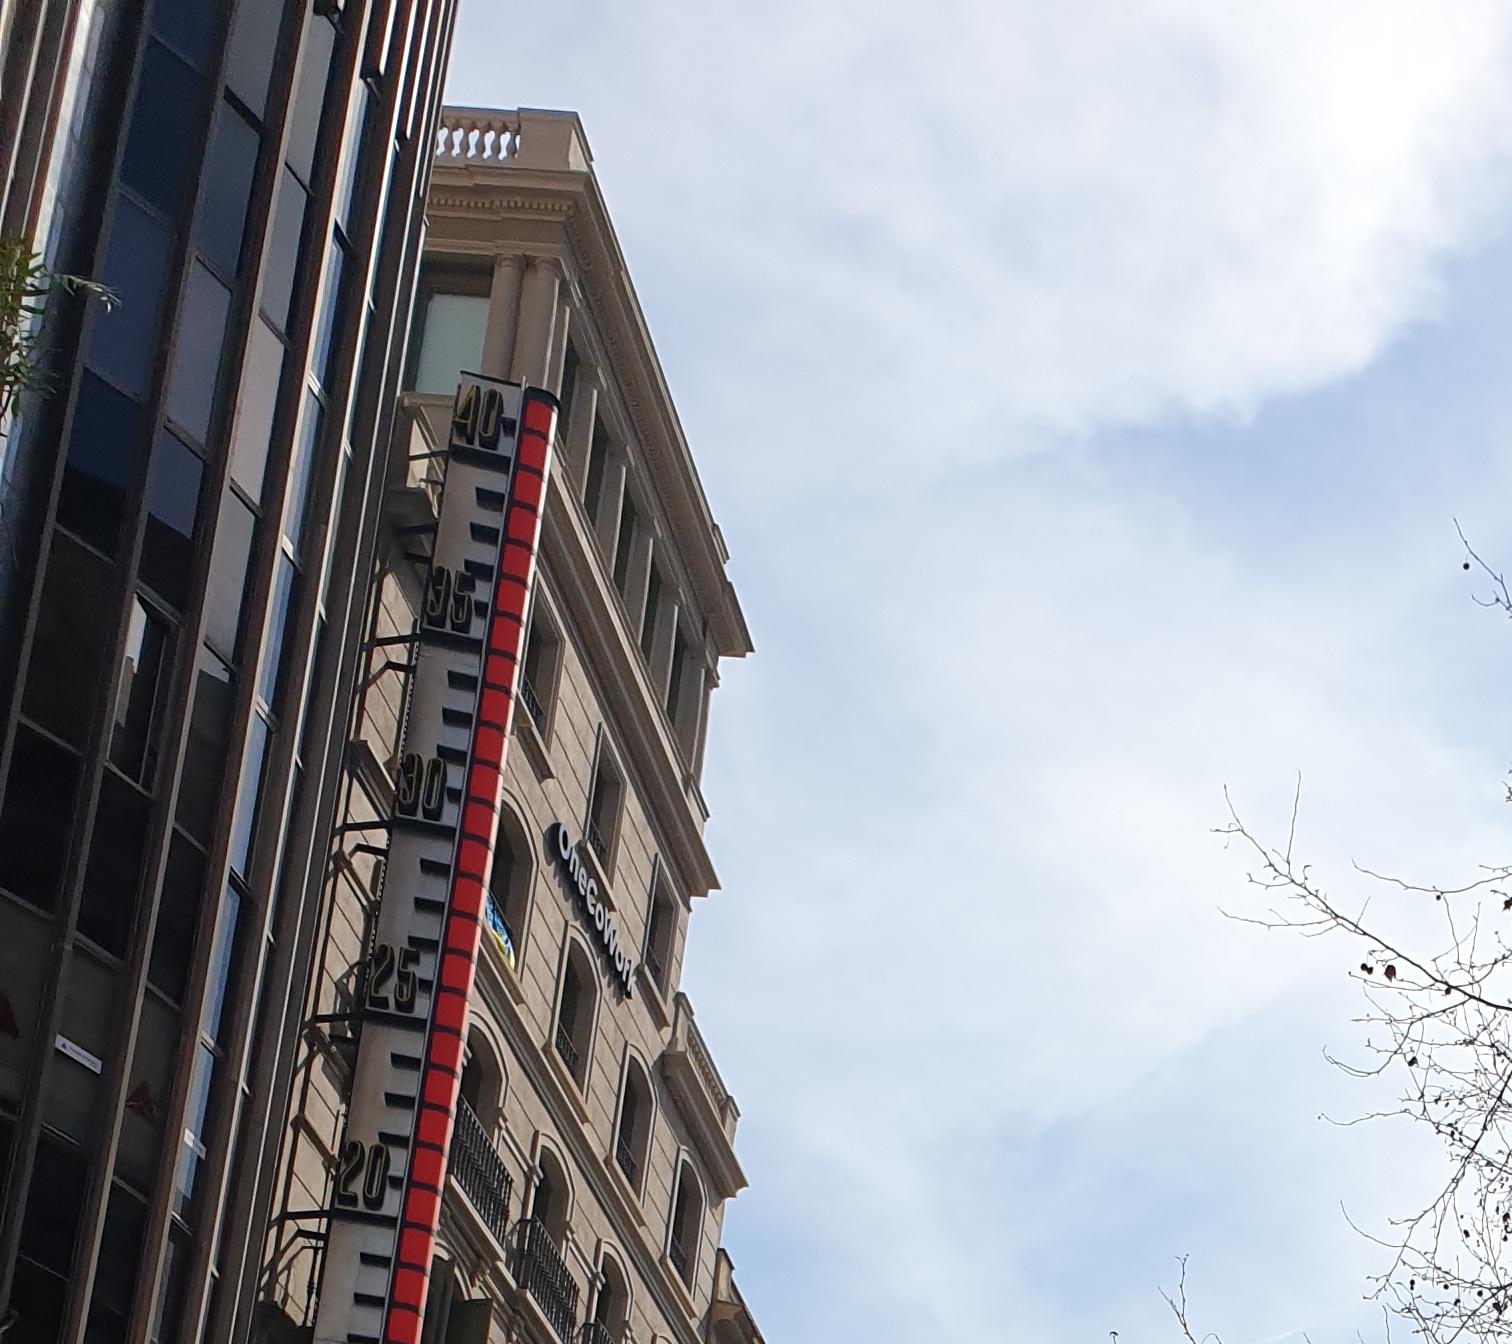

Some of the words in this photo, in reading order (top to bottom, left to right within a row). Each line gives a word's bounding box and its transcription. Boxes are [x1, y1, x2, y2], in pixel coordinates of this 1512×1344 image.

[453, 383, 503, 449] 40
[424, 565, 476, 634] 35
[398, 753, 447, 820] 30
[557, 822, 637, 994] OneCoWork
[369, 943, 420, 1013] 25
[338, 1139, 390, 1211] 20
